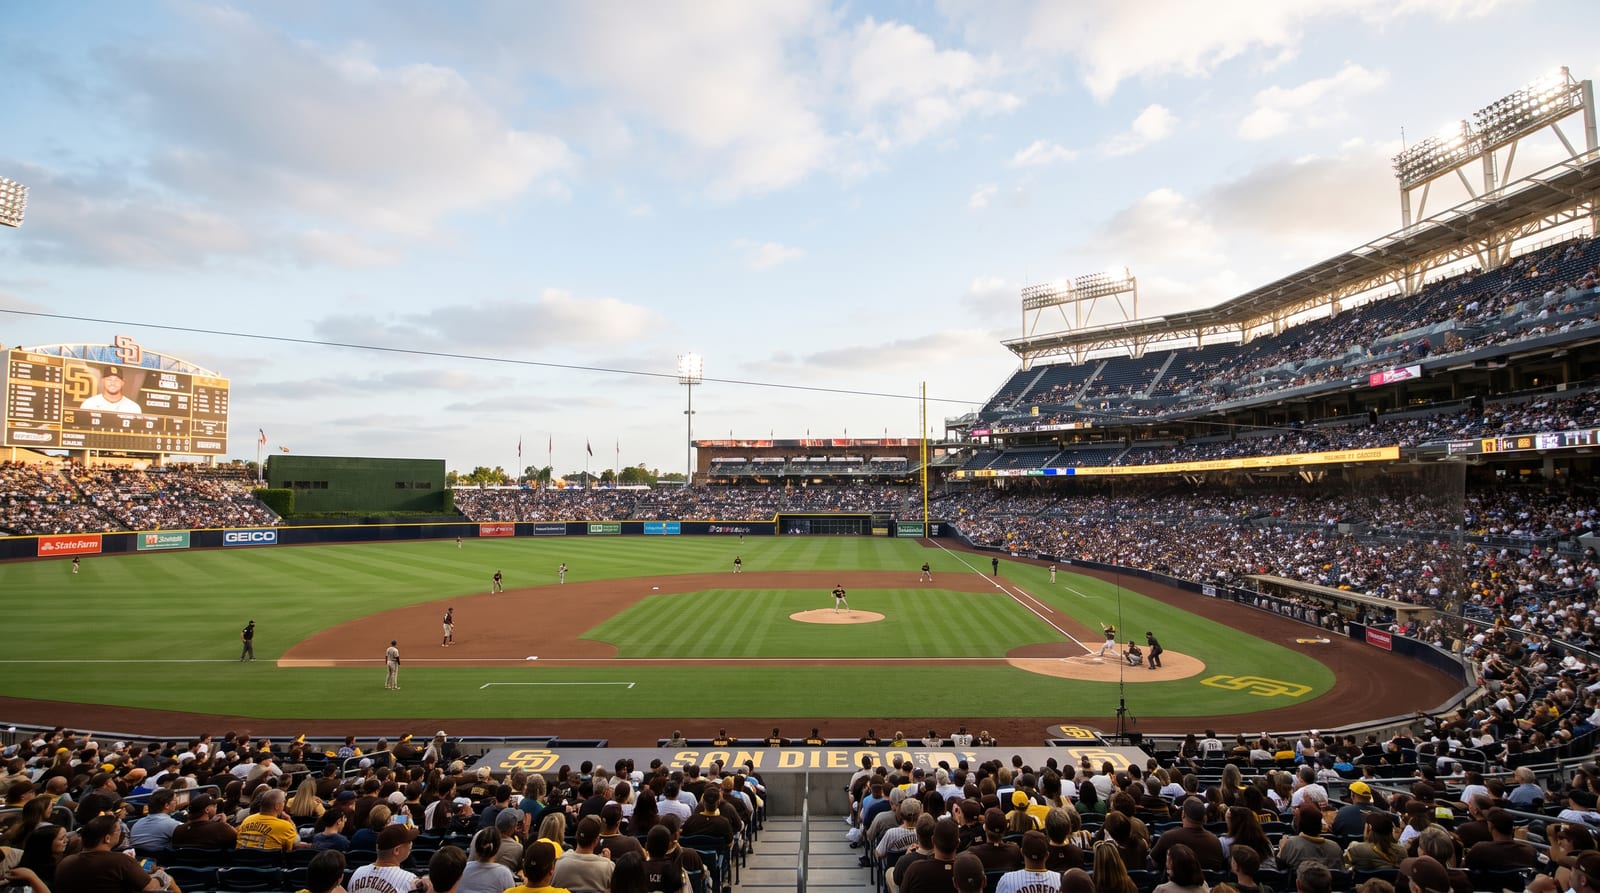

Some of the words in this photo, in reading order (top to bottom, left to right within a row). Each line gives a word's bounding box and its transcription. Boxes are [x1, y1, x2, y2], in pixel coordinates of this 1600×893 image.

[225, 531, 275, 542] GEICO
[671, 751, 765, 768] SAN
[777, 751, 913, 768] DIEGO
